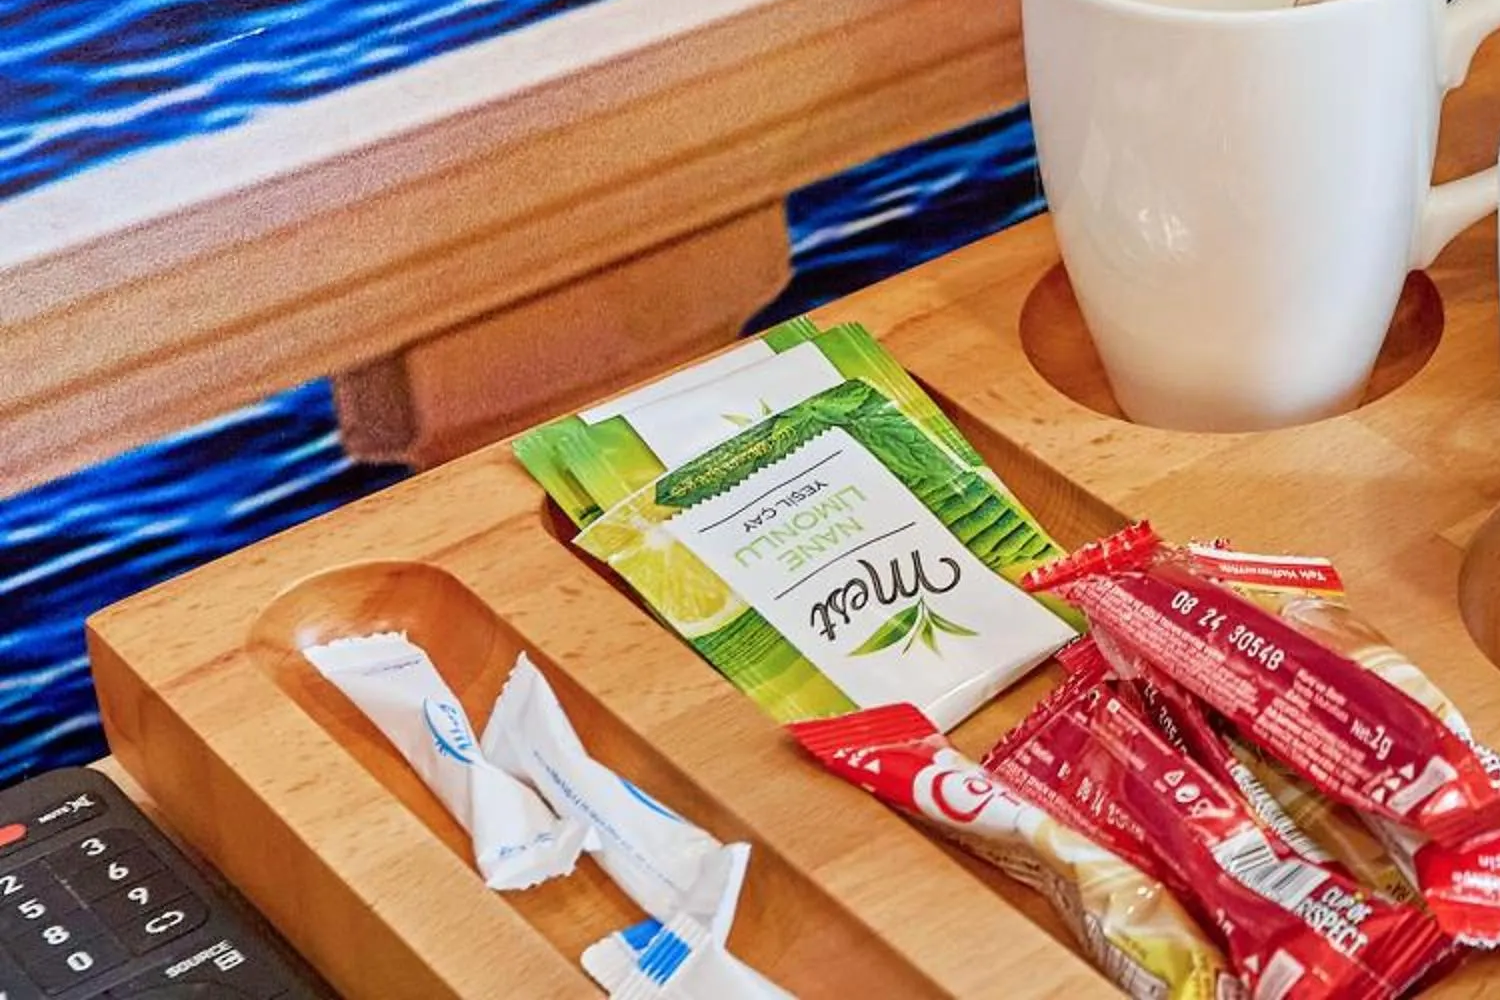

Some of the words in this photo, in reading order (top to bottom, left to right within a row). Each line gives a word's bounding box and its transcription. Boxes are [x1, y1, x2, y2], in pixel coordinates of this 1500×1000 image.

[777, 516, 865, 572] NANE
[1171, 590, 1199, 615] 08
[1198, 608, 1227, 631] 24
[81, 837, 106, 855] 3
[108, 862, 129, 880] 6
[0, 875, 24, 895] 2
[128, 887, 149, 905] 9
[18, 900, 46, 919] 5
[42, 925, 70, 945] 8
[66, 951, 94, 971] 0
